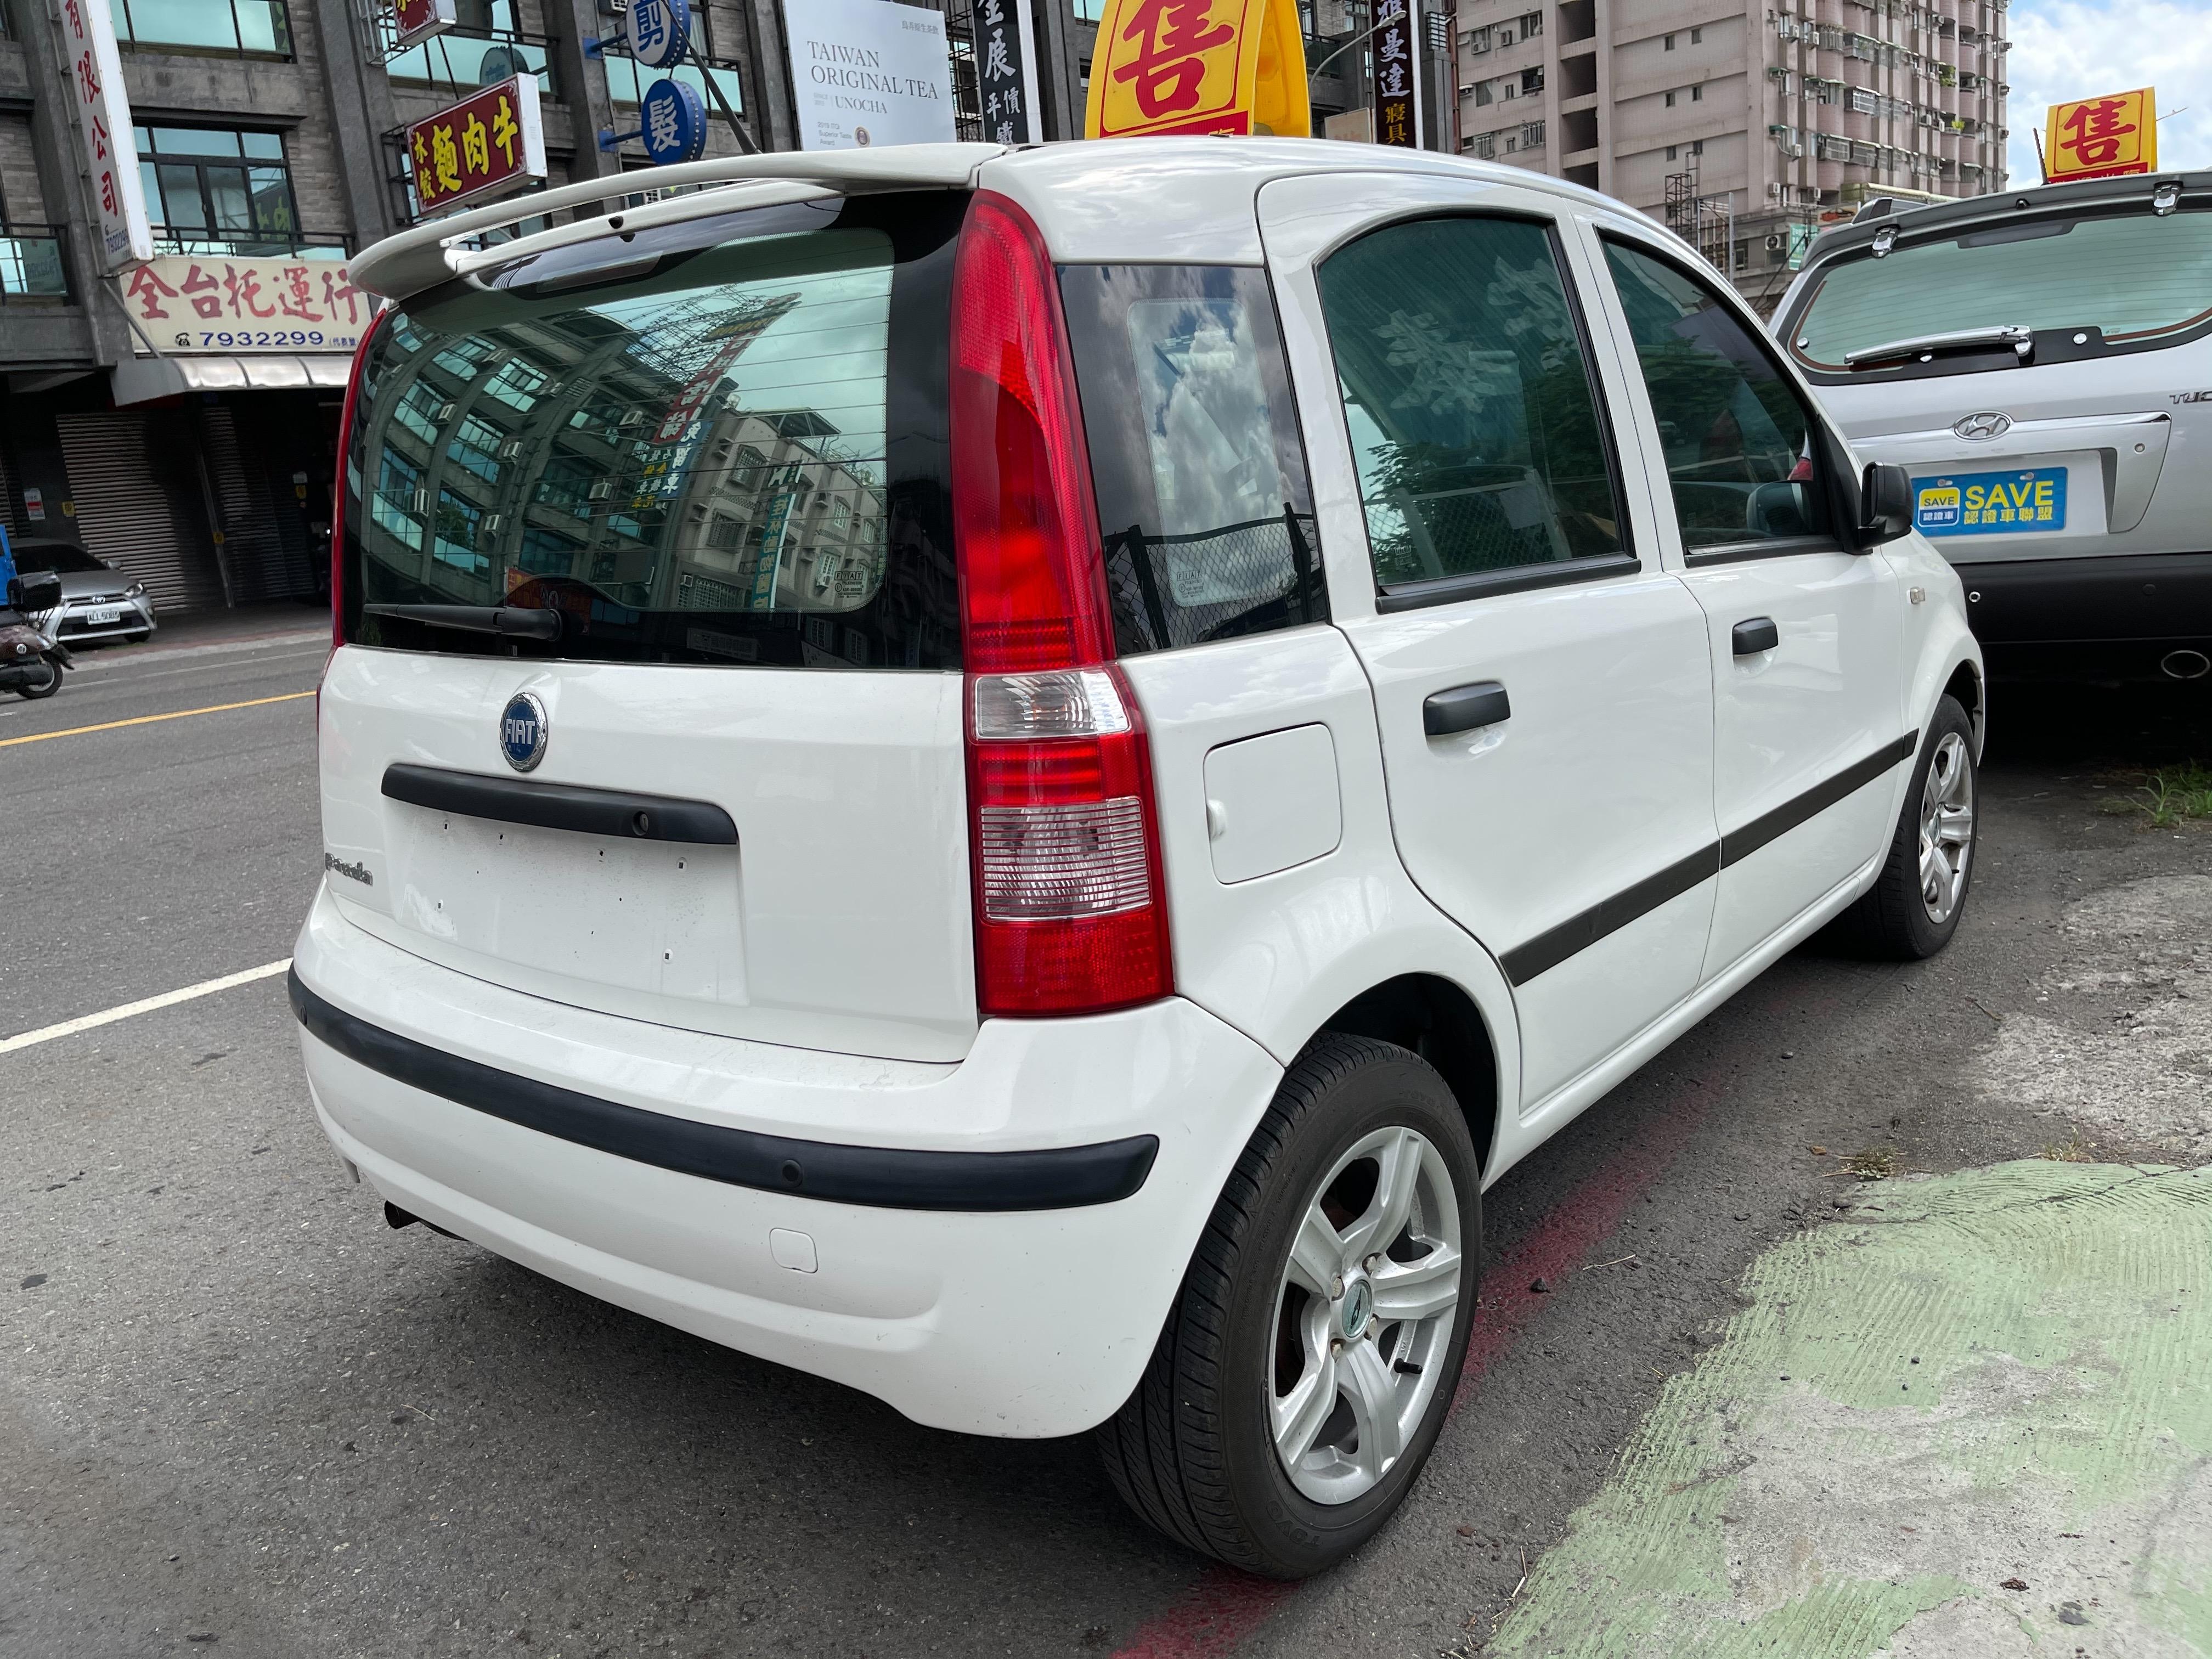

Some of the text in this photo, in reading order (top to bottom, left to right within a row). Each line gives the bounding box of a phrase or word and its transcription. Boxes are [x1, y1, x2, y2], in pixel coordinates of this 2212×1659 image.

[633, 0, 664, 52] 剪
[807, 41, 879, 68] TAIWAN
[1113, 0, 1234, 119] 售
[811, 65, 939, 100] ORIGINAL TEA
[835, 95, 888, 114] UNOCHA
[986, 87, 1020, 122] 平價
[649, 95, 680, 153] 髮
[2060, 100, 2136, 165] 售
[414, 131, 436, 201] 水餃
[127, 263, 360, 325] 全台托運行
[199, 331, 324, 347] 7932299
[1924, 496, 1954, 507] SAVE
[1965, 481, 2054, 510] SAVE
[1963, 506, 2053, 525] 認證車聯盟
[835, 571, 863, 580] FIAT
[505, 719, 535, 745] FIAT
[325, 852, 373, 887] Panda
